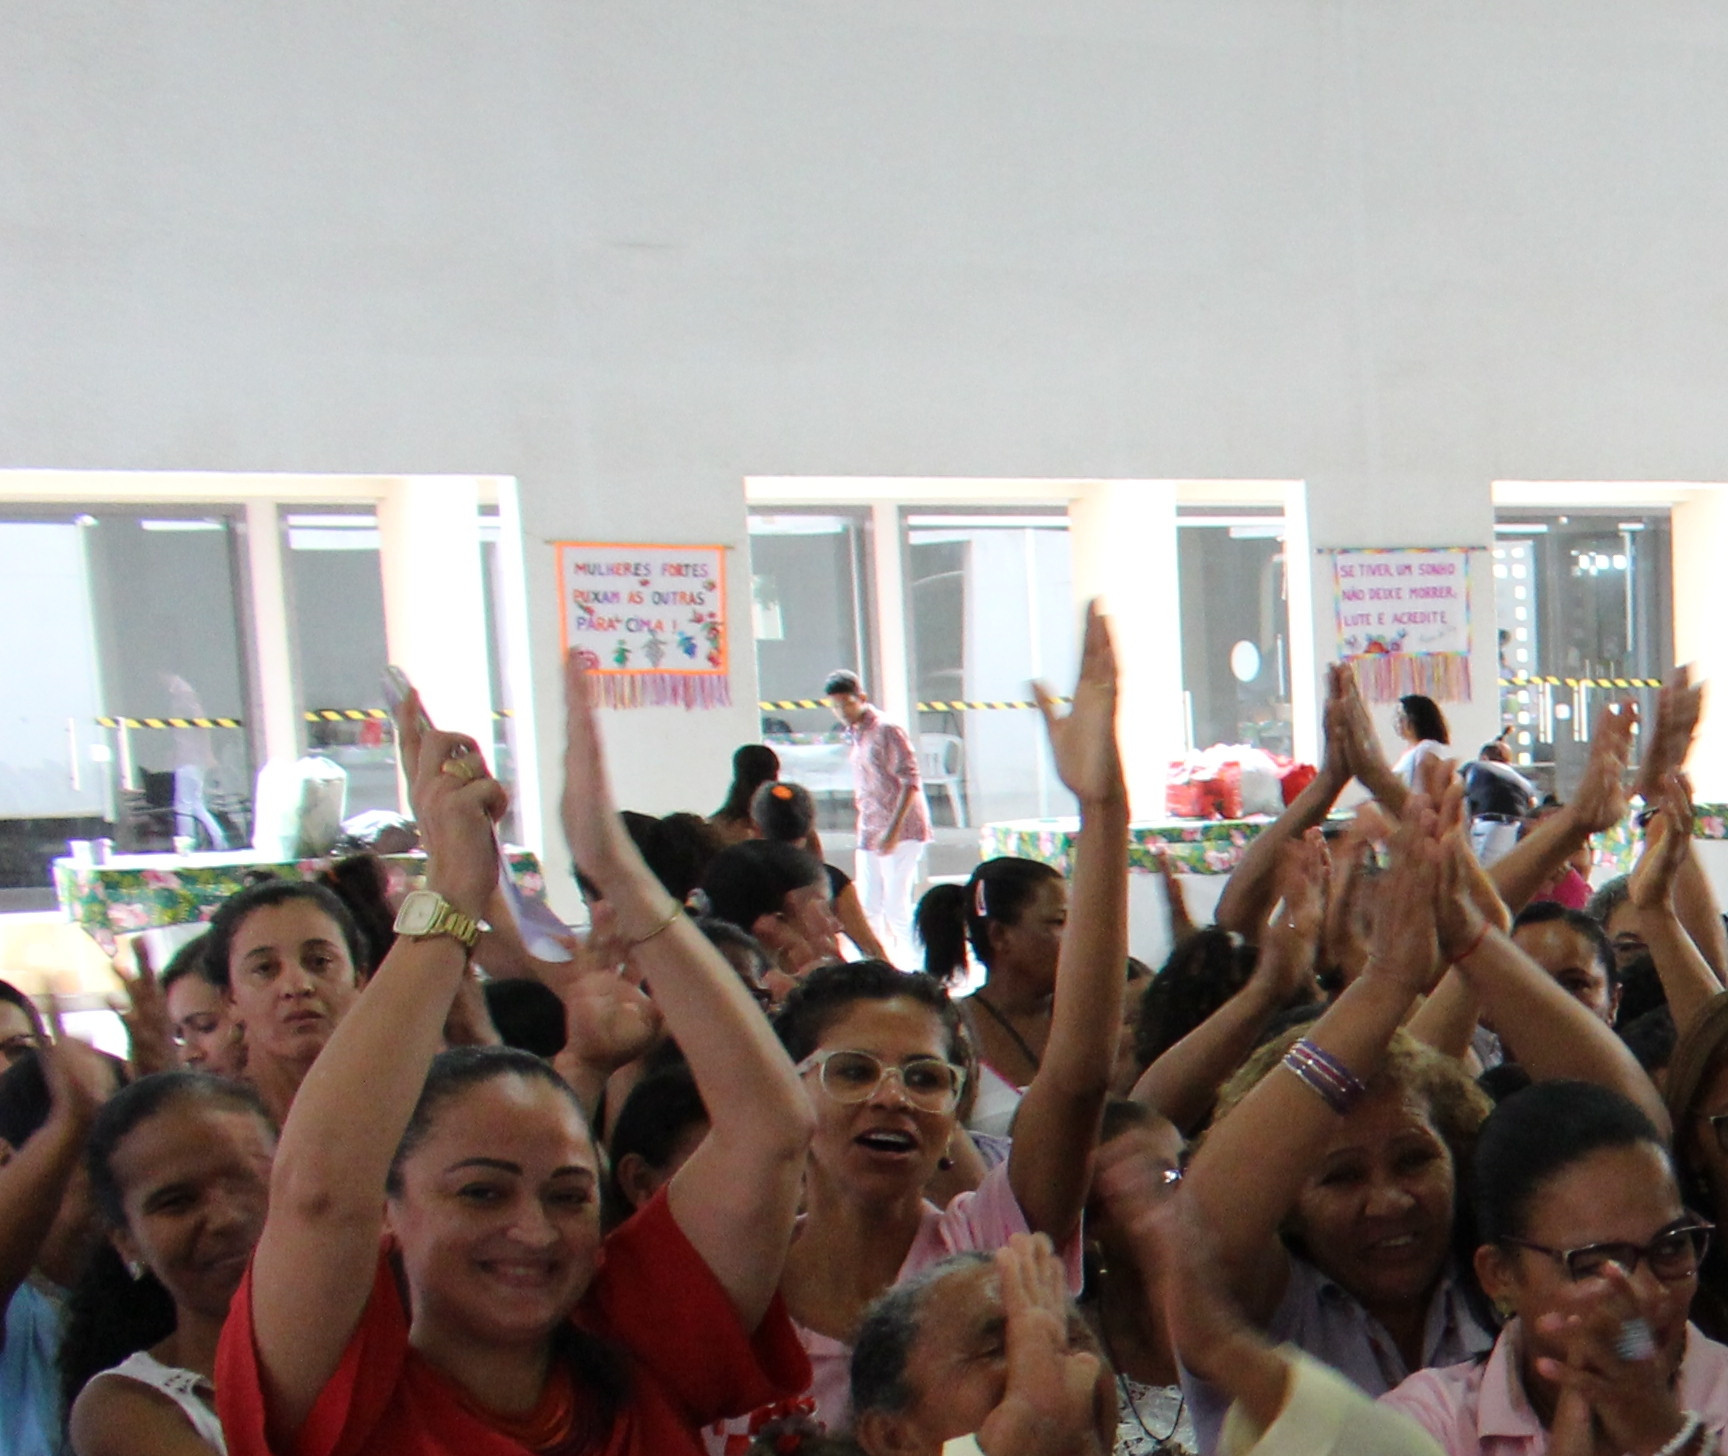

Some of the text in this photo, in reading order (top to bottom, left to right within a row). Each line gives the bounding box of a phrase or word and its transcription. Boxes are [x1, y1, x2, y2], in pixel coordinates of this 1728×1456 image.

[573, 562, 709, 578] MULHERES FORTES
[1340, 562, 1456, 578] SE TIVER UM SONHO
[572, 588, 705, 606] PUXAM AS OUTRAS
[1342, 586, 1366, 601] NÃO
[1368, 587, 1402, 600] DEIXE
[575, 616, 619, 632] PARA
[625, 616, 665, 633] CIMA
[1343, 610, 1448, 627] LUTE E ACREDITE
